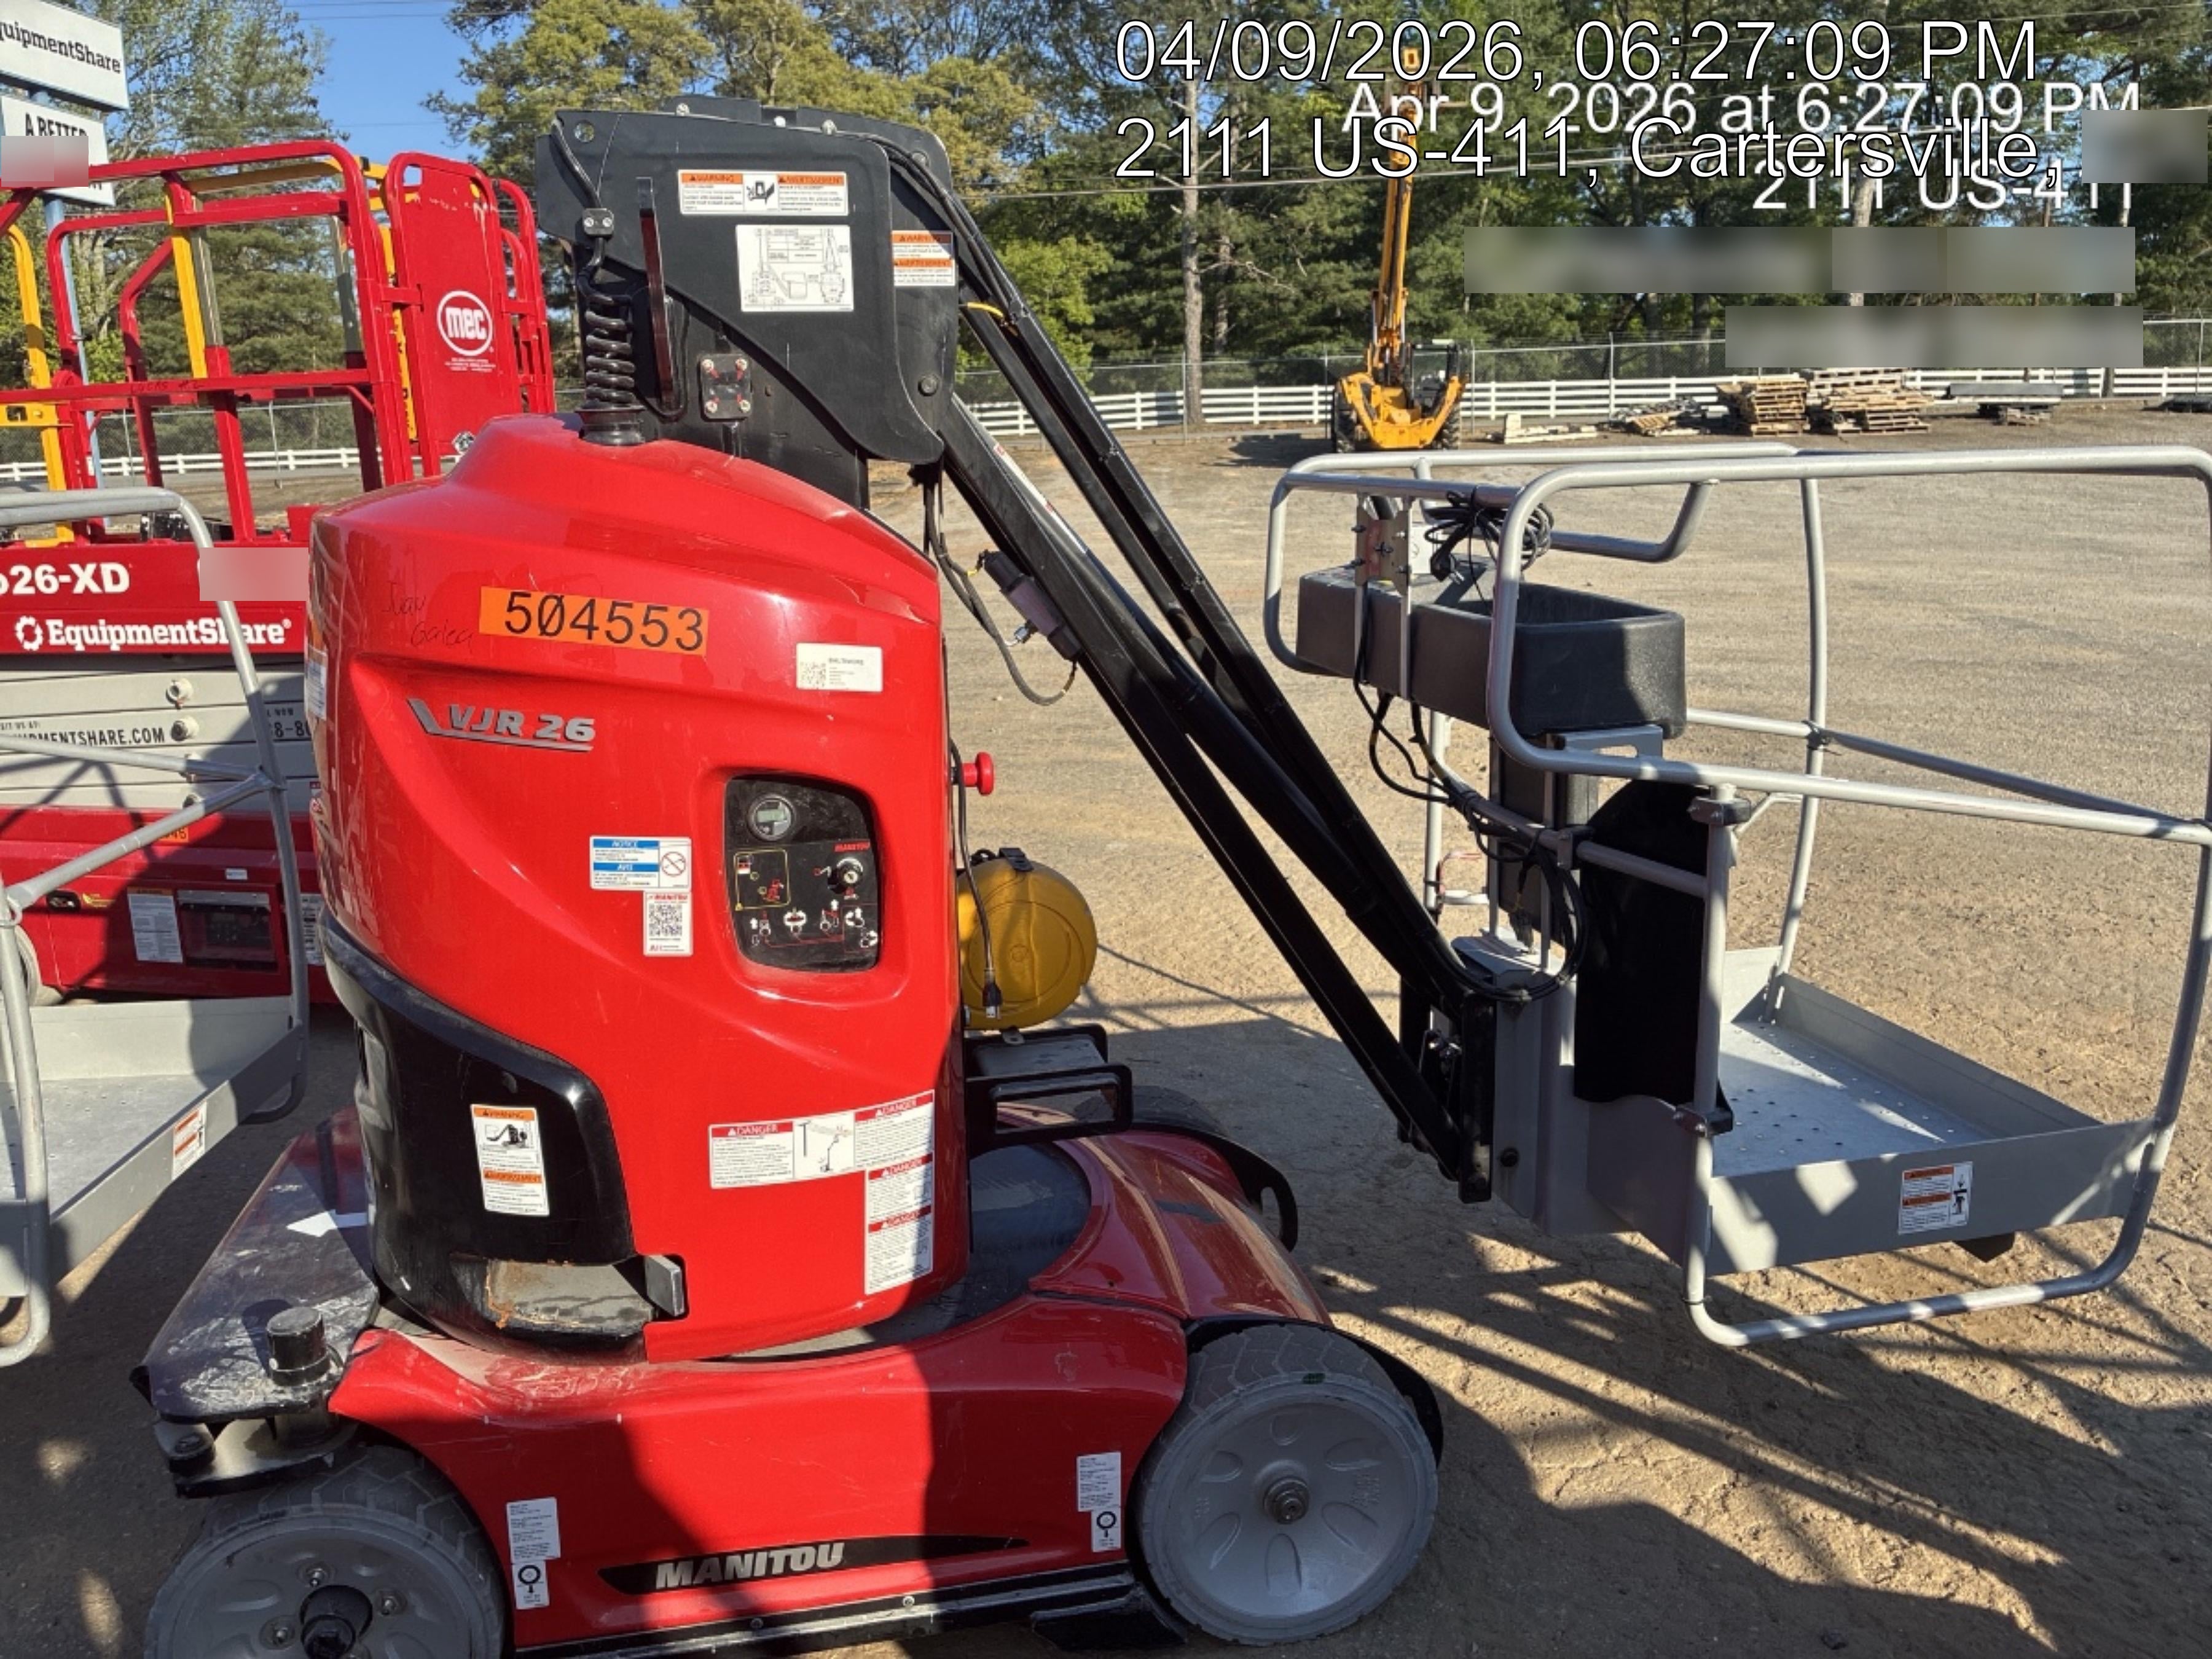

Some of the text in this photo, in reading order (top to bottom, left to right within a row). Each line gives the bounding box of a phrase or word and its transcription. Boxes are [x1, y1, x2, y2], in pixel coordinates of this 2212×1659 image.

[504, 591, 704, 652] 504553
[450, 704, 596, 743] VJR 26
[882, 1099, 917, 1115] DANGER
[737, 1123, 779, 1135] DANGER
[891, 1159, 923, 1175] DANGER
[654, 1542, 844, 1590] MANITOU
